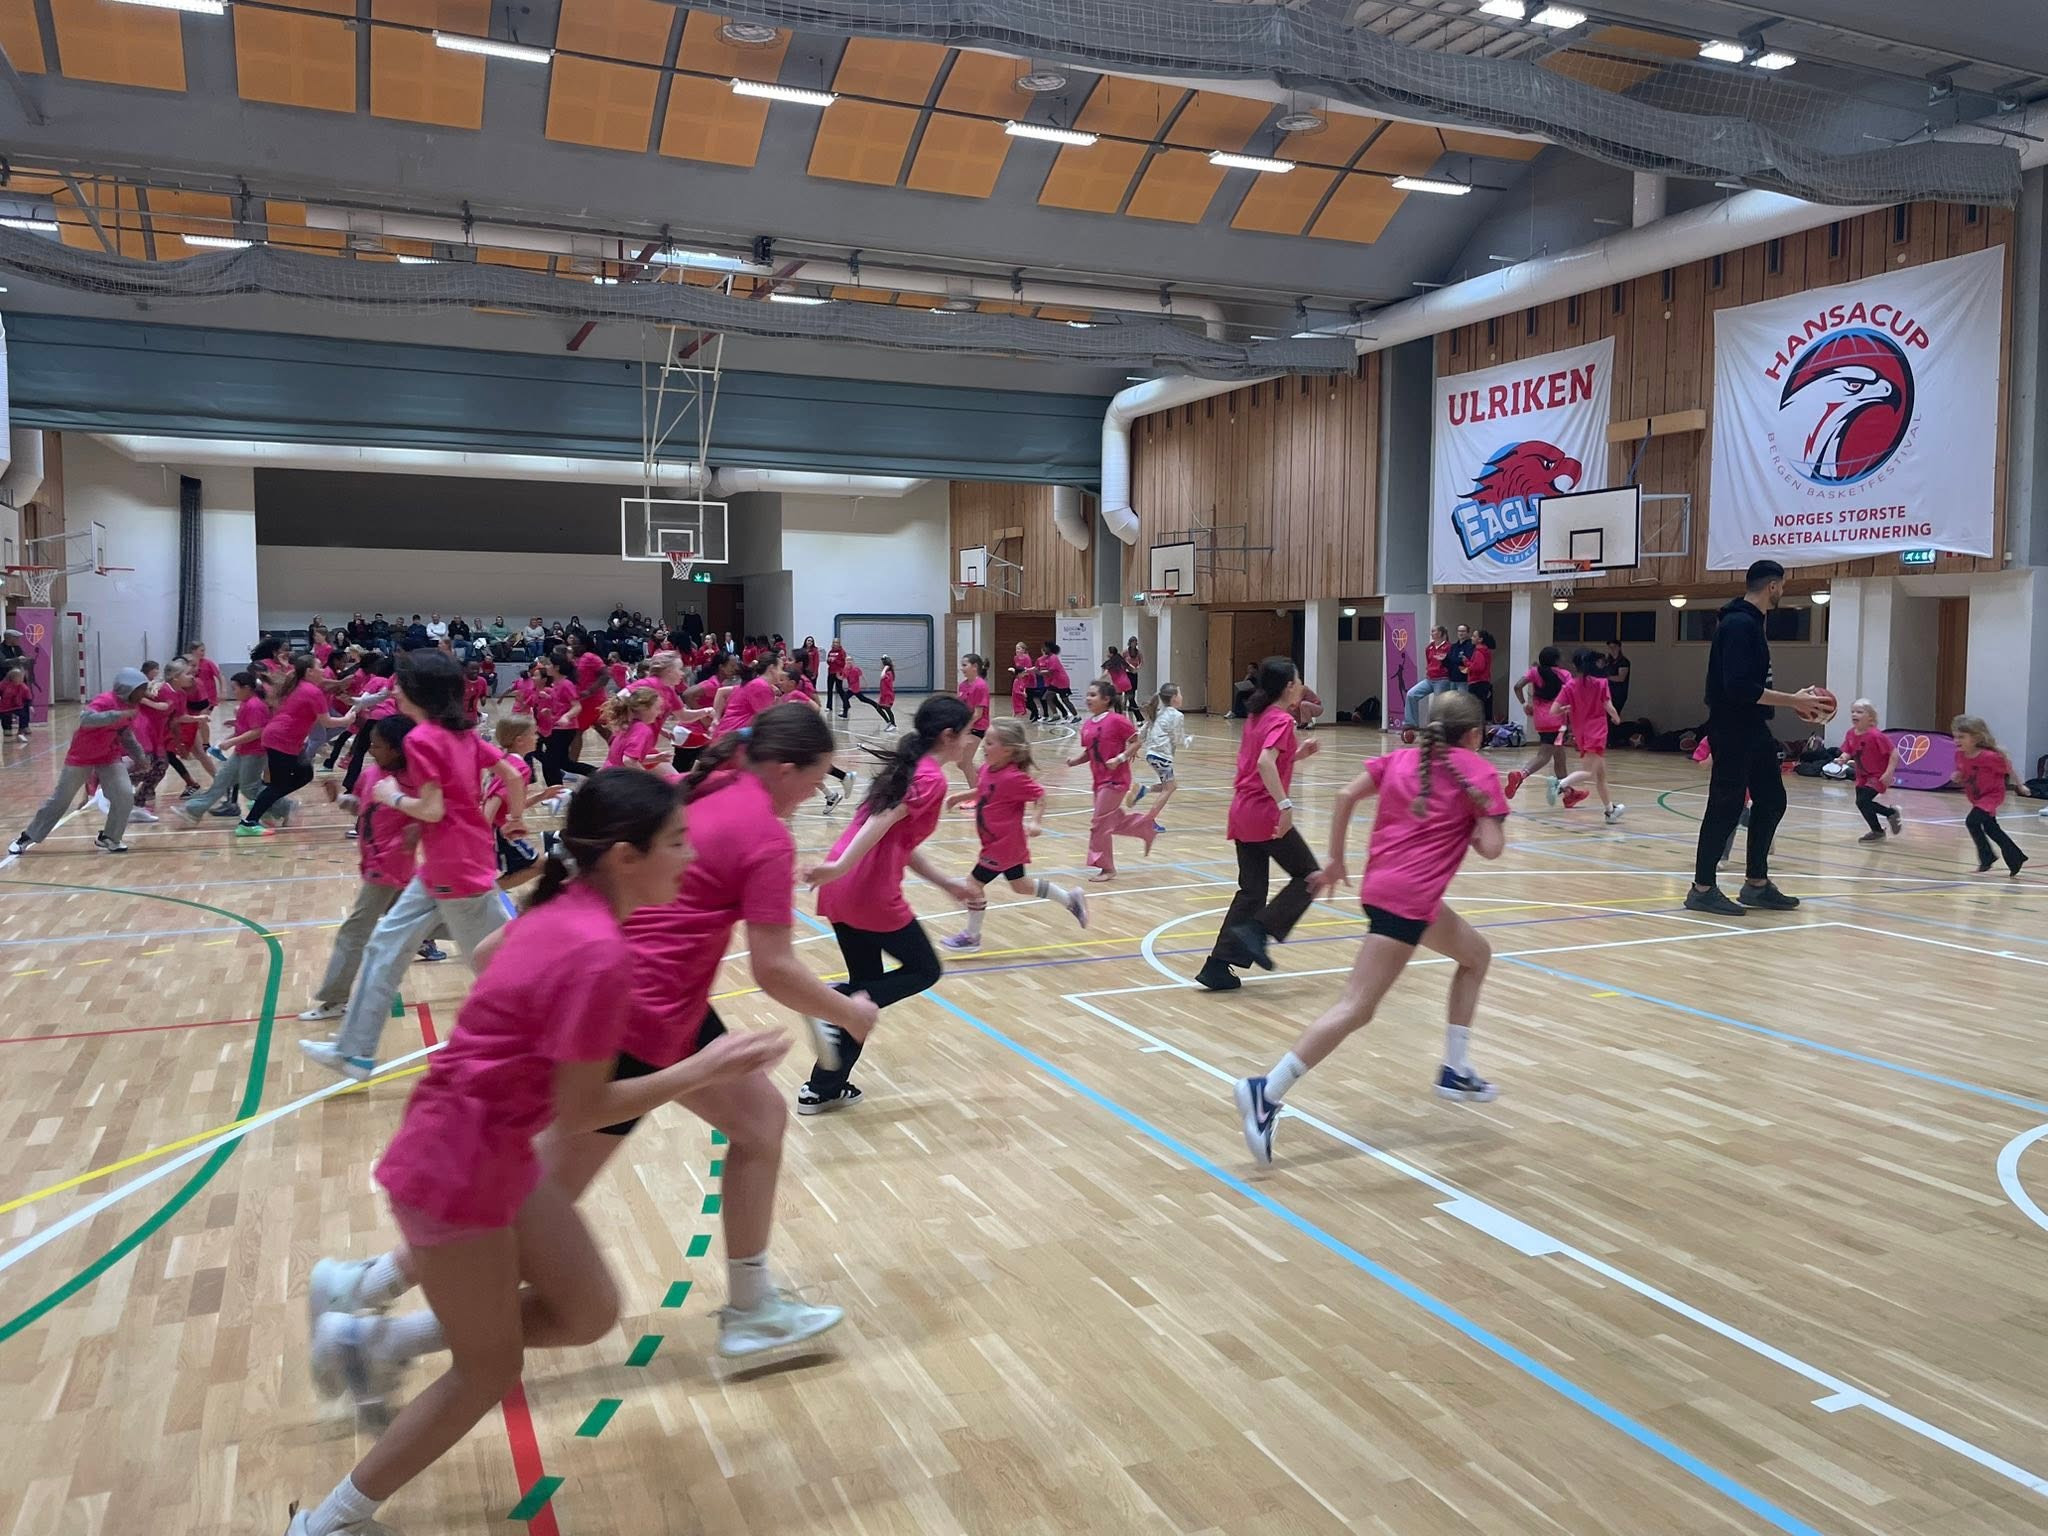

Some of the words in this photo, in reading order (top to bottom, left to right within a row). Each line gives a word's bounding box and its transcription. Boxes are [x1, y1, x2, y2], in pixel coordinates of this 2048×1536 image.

[1765, 302, 1929, 380] HANSACUP
[1449, 363, 1595, 426] ULRIKEN
[1767, 432, 1802, 491] BERGEN
[1807, 413, 1922, 499] BASKETFESTIVAL
[1753, 523, 1932, 546] BASKETBALLTURNERING
[1774, 512, 1833, 527] NORGES
[1839, 505, 1906, 523] STØRSTE
